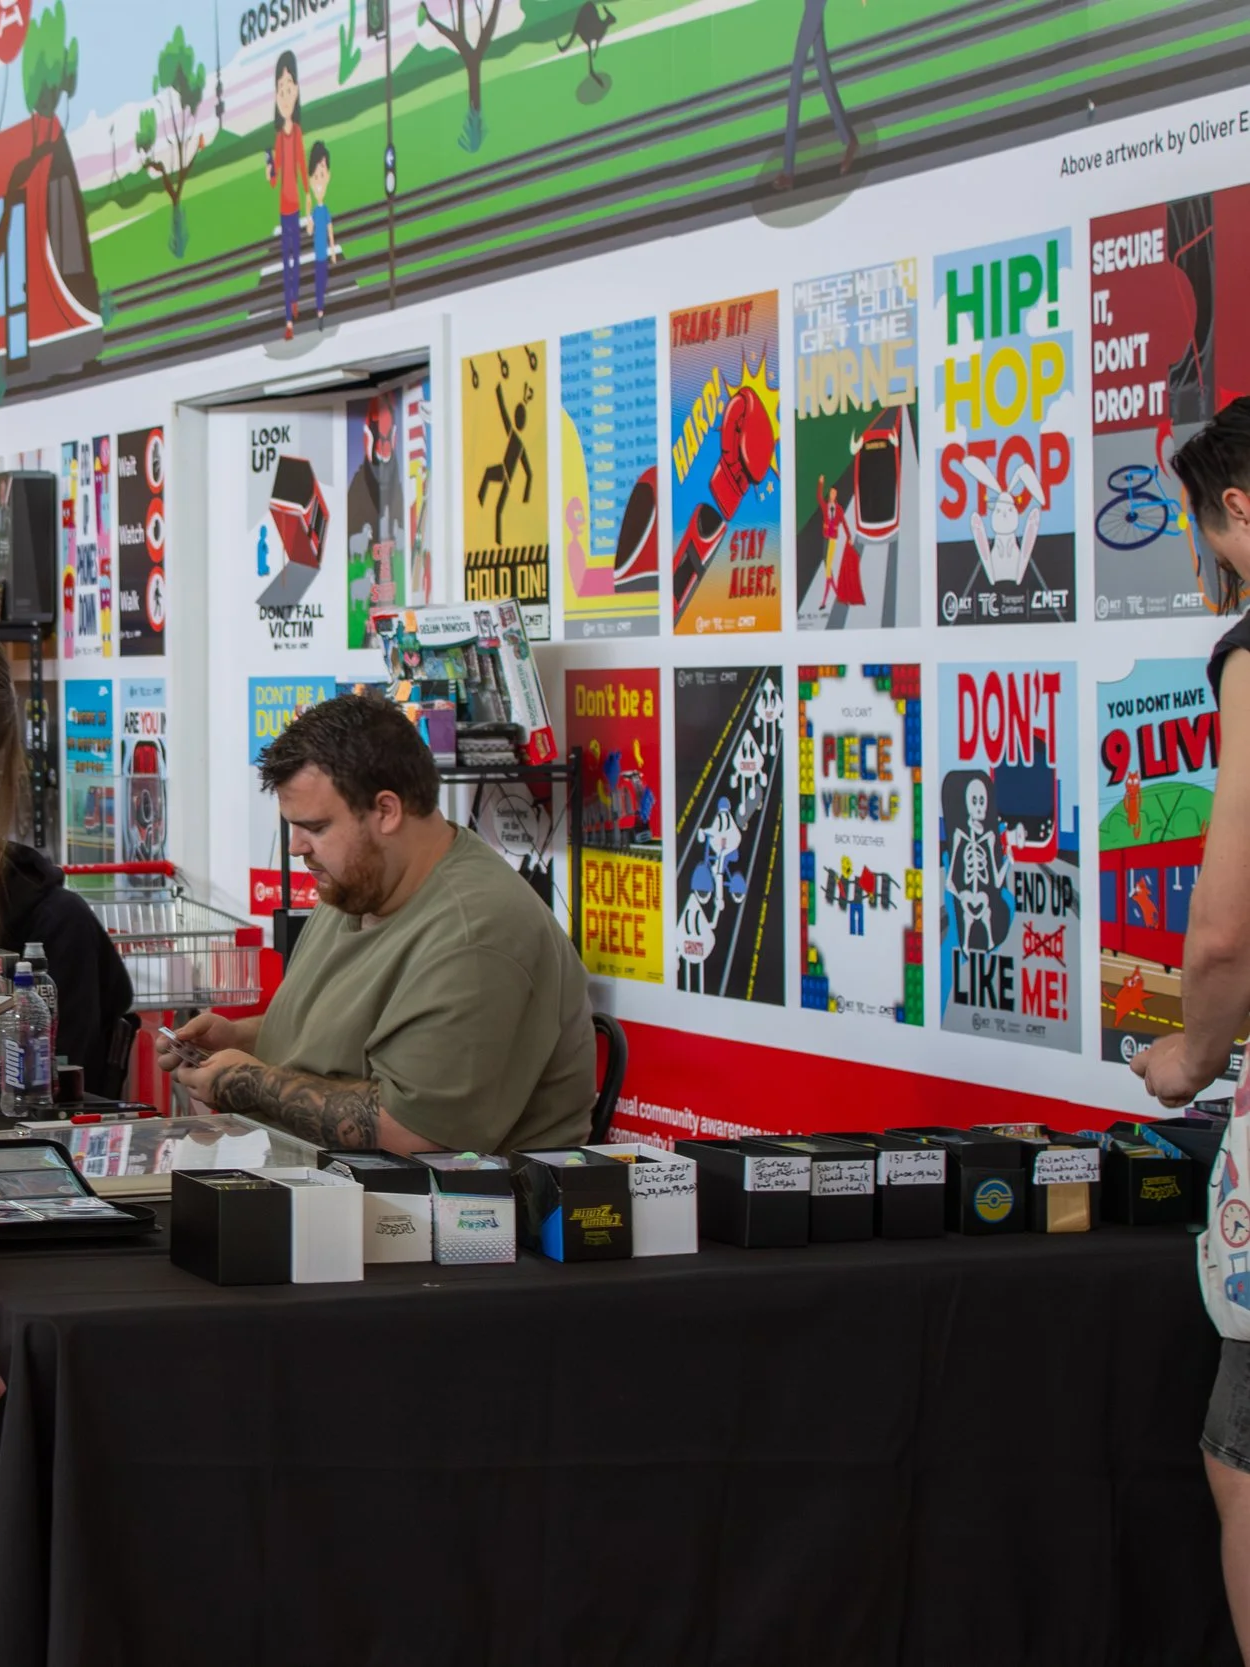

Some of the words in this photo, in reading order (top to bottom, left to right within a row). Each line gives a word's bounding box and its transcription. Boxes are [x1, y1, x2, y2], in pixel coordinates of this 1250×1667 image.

[1060, 153, 1102, 178] Above
[1106, 133, 1164, 166] artwork
[1168, 130, 1186, 154] by
[1189, 118, 1236, 145] Oliver
[1092, 228, 1164, 275] SECURE
[794, 274, 853, 308] MESS
[855, 260, 915, 295] WITH
[946, 239, 1059, 346] HIP!
[673, 307, 721, 347] TRAMS
[726, 301, 753, 338] HIT
[804, 300, 847, 328] THE
[858, 289, 915, 317] BULL
[1093, 290, 1113, 326] IT,
[853, 313, 908, 345] THE
[1094, 332, 1149, 374] DON'T
[797, 338, 916, 420] HORNS
[944, 341, 1065, 433] HOP
[1094, 384, 1144, 423] DROP
[1148, 381, 1166, 417] IT
[251, 425, 291, 447] LOOK
[672, 366, 724, 485] HARD!
[119, 456, 137, 478] Wait
[251, 447, 277, 473] UP
[939, 431, 1070, 520] STOP
[119, 524, 145, 545] Watch
[729, 528, 767, 562] STAY
[120, 591, 140, 612] Walk
[467, 567, 511, 601] HOLD
[517, 564, 547, 600] ON!
[729, 565, 776, 599] ALERT.
[259, 604, 295, 621] DON'T
[296, 602, 324, 619] FALL
[269, 621, 314, 638] VICTIM
[255, 686, 292, 705] DON'T
[297, 687, 314, 705] BE
[316, 688, 325, 702] A
[575, 683, 615, 717] Don't
[619, 683, 640, 717] be
[643, 689, 654, 717] a
[1107, 698, 1134, 719] YOU
[1136, 693, 1170, 714] DONT
[1173, 687, 1205, 710] HAVE
[124, 712, 139, 734] ARE
[140, 711, 159, 734] YOU
[957, 669, 1061, 765] DON'T
[822, 734, 893, 781] PIECE
[1101, 728, 1131, 787] 9
[1137, 711, 1221, 780] LIV
[822, 790, 900, 822] YOURSELF
[585, 860, 660, 911] ROKEN
[1014, 871, 1046, 914] END
[1050, 874, 1073, 917] UP
[585, 908, 646, 958] PIECE
[1022, 921, 1066, 962] dead
[953, 948, 1014, 1012] LIKE
[1021, 967, 1068, 1022] ME!
[5, 1039, 25, 1089] pump
[638, 1101, 700, 1136] community
